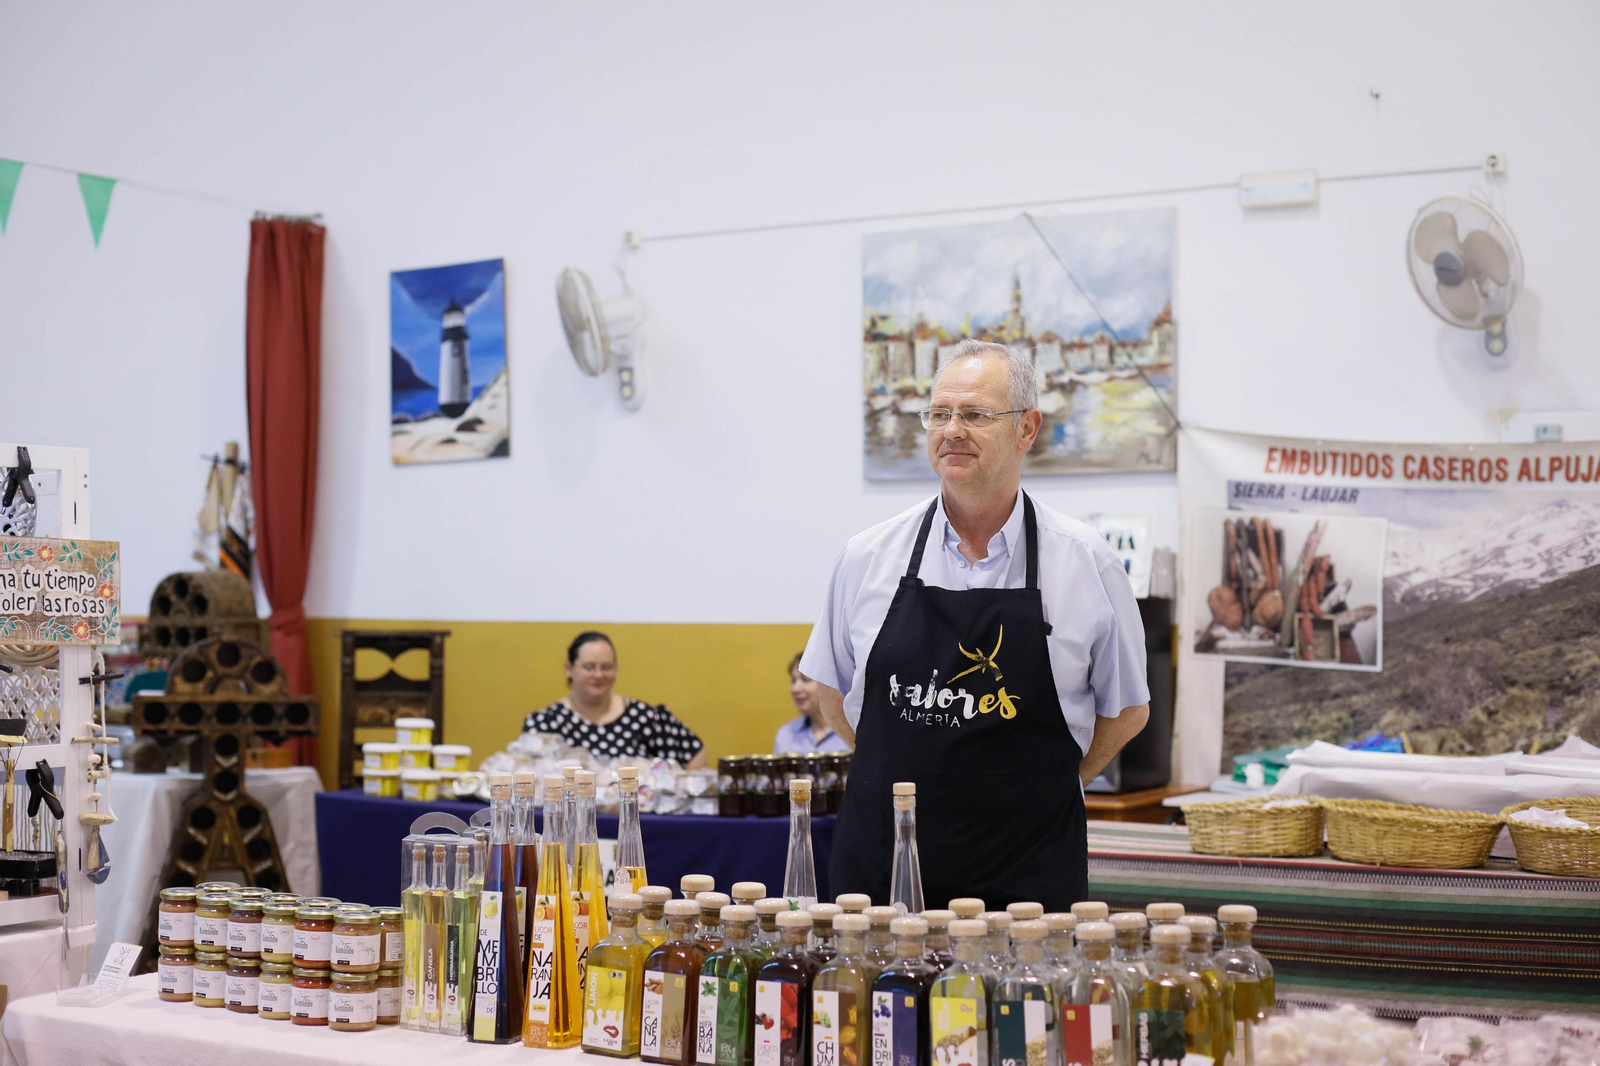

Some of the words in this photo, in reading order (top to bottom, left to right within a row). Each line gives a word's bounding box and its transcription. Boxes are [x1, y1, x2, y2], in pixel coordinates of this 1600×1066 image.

[1264, 446, 1393, 479] EMBUTIDOS
[1403, 454, 1509, 483] CASEROS
[1233, 481, 1285, 500] SIERRA
[1301, 485, 1360, 504] LAUJAR
[23, 569, 40, 589] tu
[45, 568, 95, 594] tiempo
[2, 592, 36, 611] oler
[42, 594, 61, 613] las
[65, 597, 105, 614] rosas
[535, 926, 553, 934] LICOR
[534, 933, 542, 941] DE
[479, 940, 499, 953] ME
[532, 950, 553, 967] NA
[531, 967, 552, 982] RAN
[532, 982, 551, 999] JA
[589, 971, 598, 1007] LIMÓN
[644, 1016, 658, 1028] CA
[644, 1026, 657, 1037] NE
[699, 1026, 713, 1039] BA
[1139, 1011, 1149, 1060] HIERBAS
[644, 1035, 657, 1048] LA
[699, 1037, 712, 1045] BUE
[817, 1041, 834, 1054] CH
[874, 1038, 888, 1049] EN
[698, 1044, 713, 1054] NA
[874, 1050, 891, 1061] DRI
[816, 1054, 834, 1065] UM
